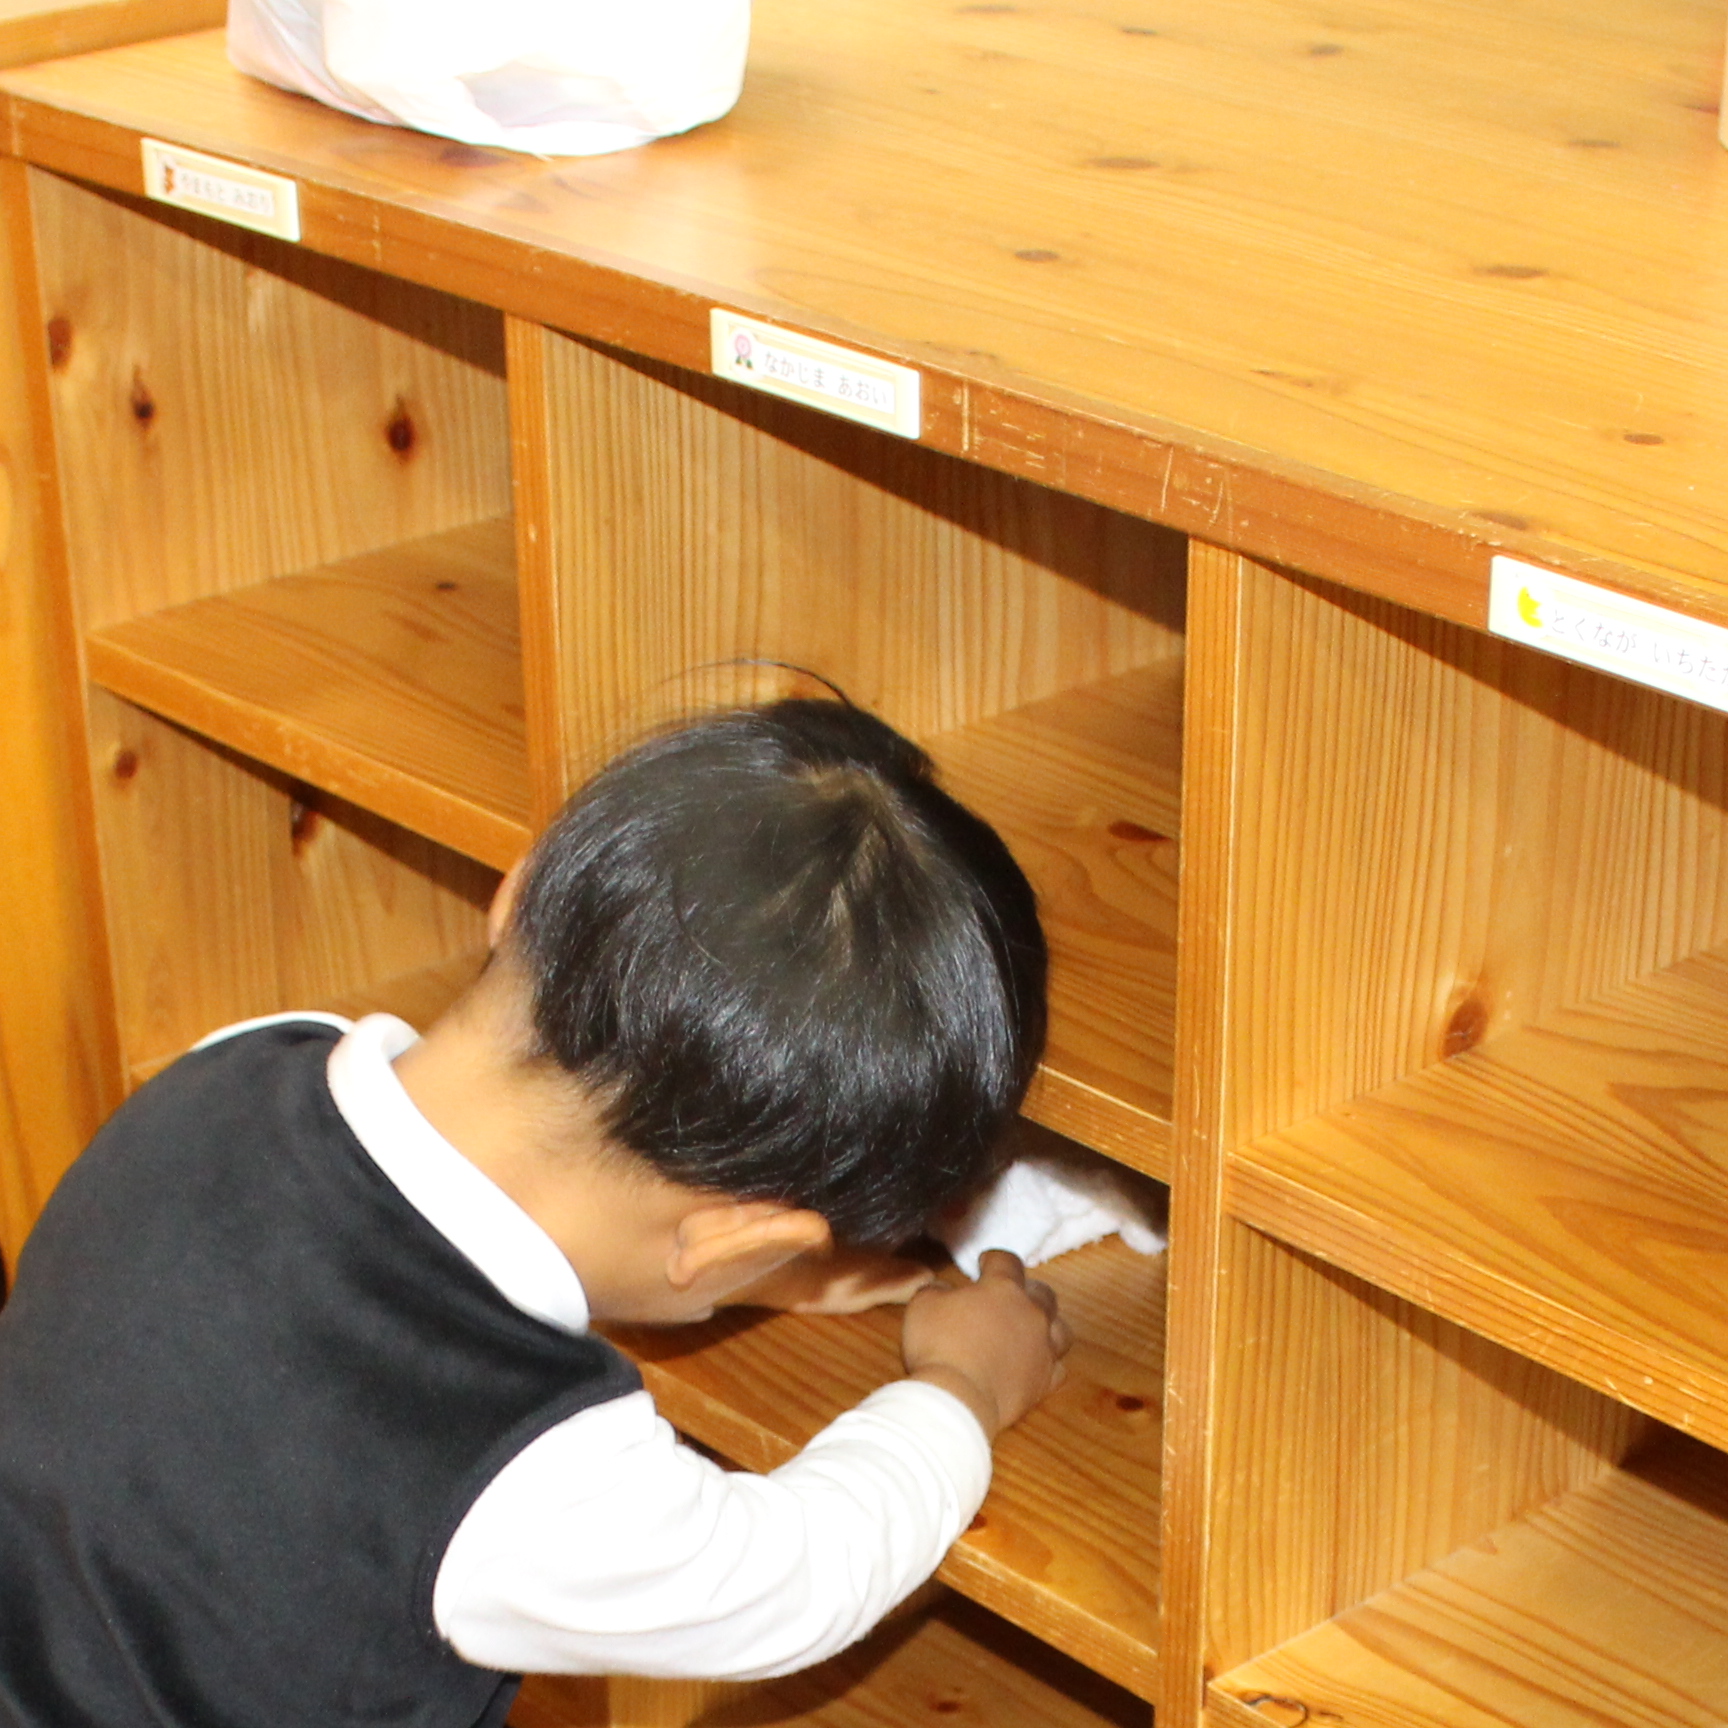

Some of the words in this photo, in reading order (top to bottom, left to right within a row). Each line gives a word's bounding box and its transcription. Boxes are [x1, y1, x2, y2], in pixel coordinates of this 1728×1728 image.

[763, 350, 826, 388] なかじま
[837, 375, 888, 405] あおい
[1551, 608, 1637, 654] とくなが
